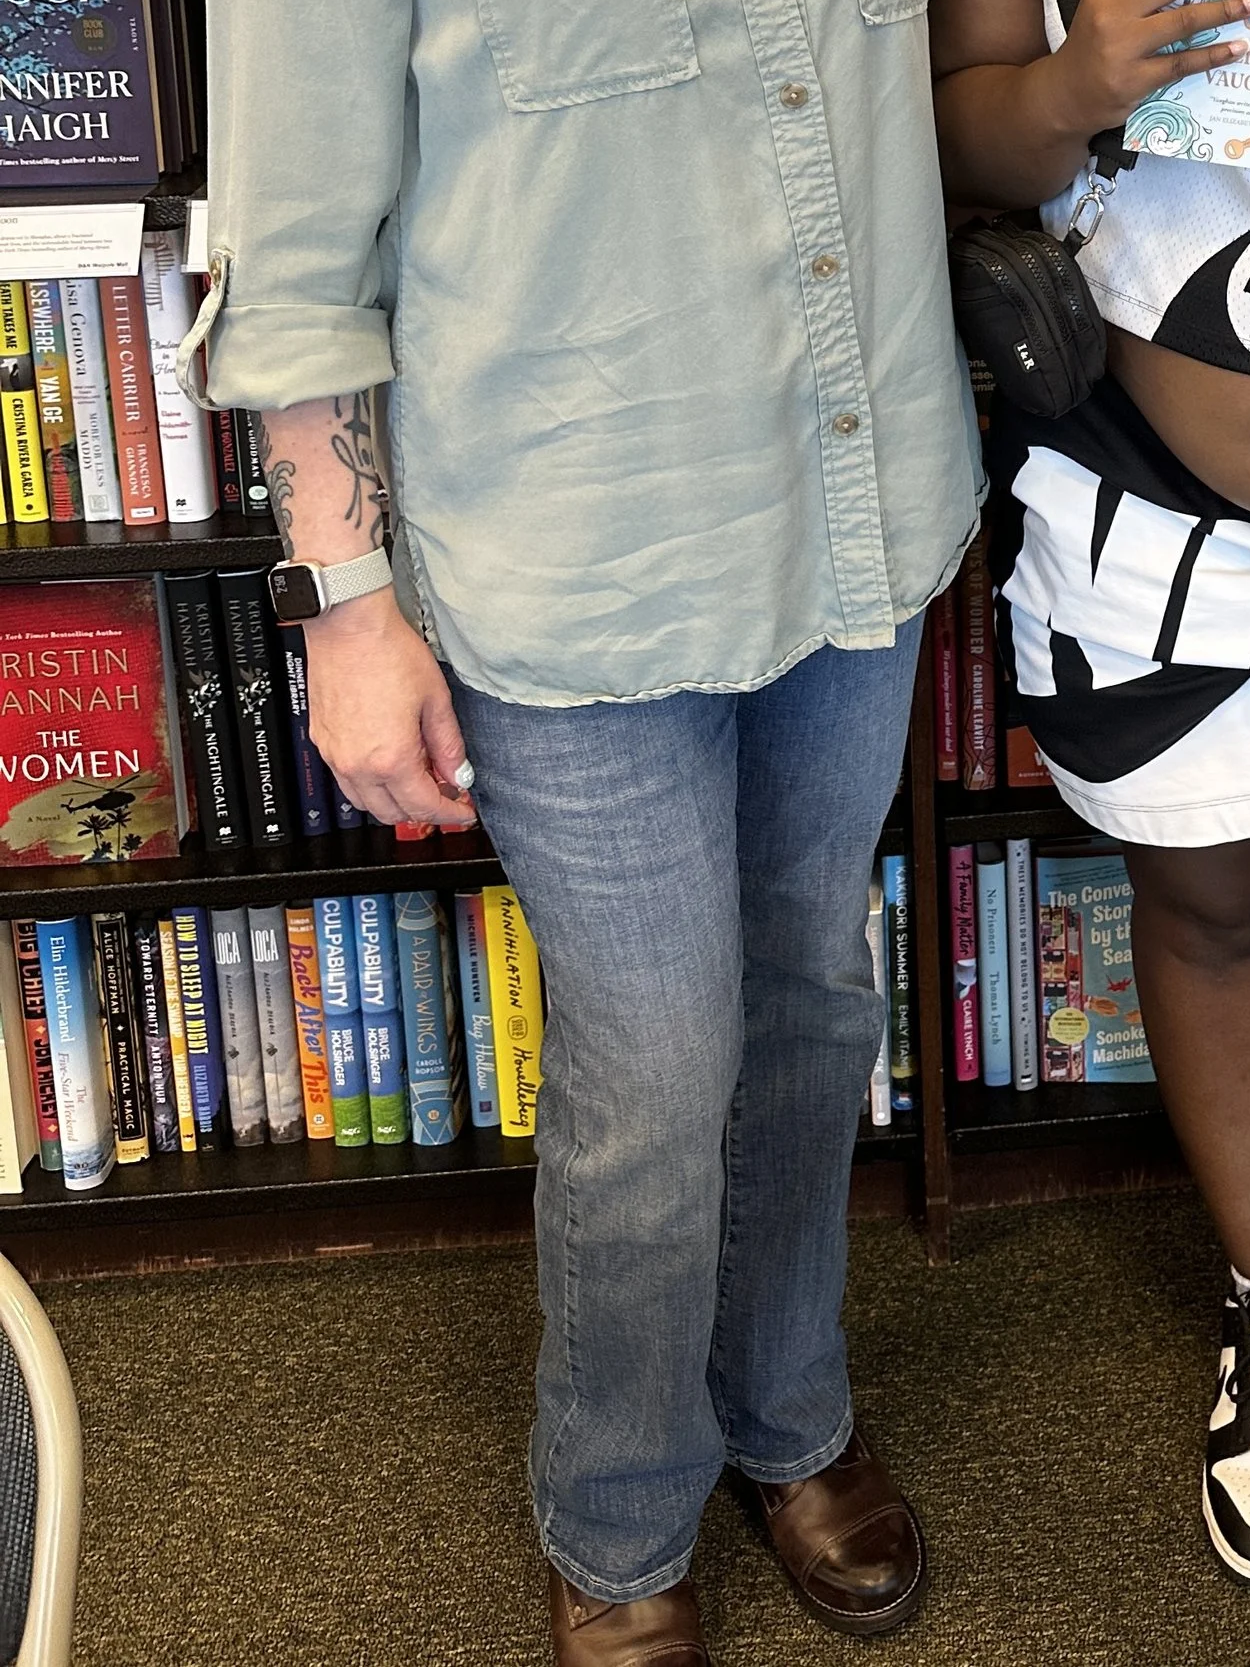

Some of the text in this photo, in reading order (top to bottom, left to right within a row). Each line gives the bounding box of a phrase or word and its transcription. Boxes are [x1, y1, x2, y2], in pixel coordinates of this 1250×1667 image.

[83, 18, 104, 29] BOOK
[84, 28, 104, 39] CLUB
[112, 286, 140, 422] LETTER CARRIER
[39, 375, 63, 424] YAN GE
[12, 398, 34, 498] CRISTINA RIVERA GARZA
[176, 602, 196, 667] HANNAH
[196, 602, 215, 662] KRISTIN
[36, 729, 83, 749] THE
[204, 713, 228, 819] THE NIGHTINGALE
[35, 814, 61, 823] Novel
[360, 898, 385, 1006] CULPABILITY
[955, 861, 976, 1061] A Family Matter CLAIRE LYNCH
[49, 936, 76, 1042] Elin Hilderbrand
[104, 932, 135, 1130] ALICE HOFFMAN PRACTICAL MAGIC
[290, 943, 327, 1105] Back After This
[368, 1027, 382, 1084] HOLSINGER
[378, 1027, 390, 1061] BRUCE
